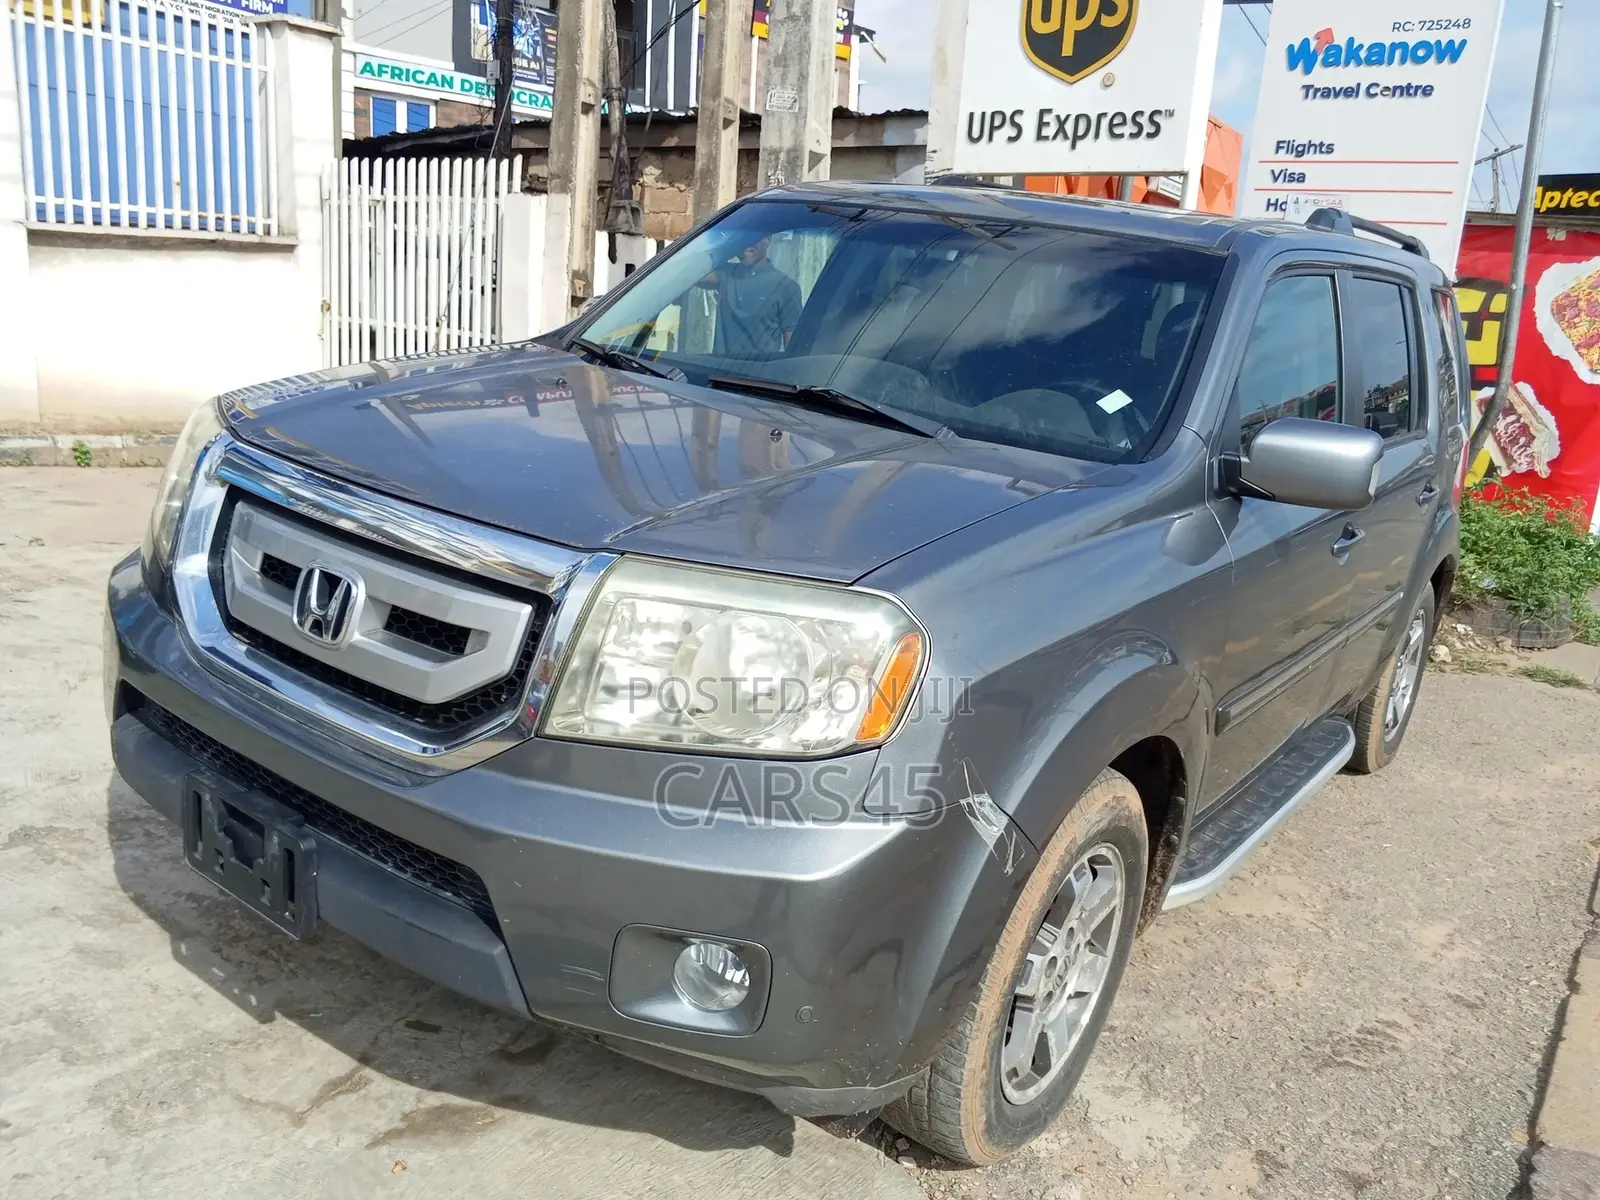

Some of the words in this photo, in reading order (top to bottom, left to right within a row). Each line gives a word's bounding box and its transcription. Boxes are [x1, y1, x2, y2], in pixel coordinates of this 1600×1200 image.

[205, 5, 240, 18] MIGRATION
[1391, 21, 1415, 33] RC:
[1418, 17, 1472, 32] 725248
[1286, 36, 1468, 75] Wakanow
[359, 61, 454, 90] AFRICAN
[1301, 83, 1361, 101] Travel
[1365, 82, 1435, 99] Centre
[967, 109, 1024, 144] UPS
[1274, 140, 1335, 158] Flights
[1270, 169, 1306, 184] Visa
